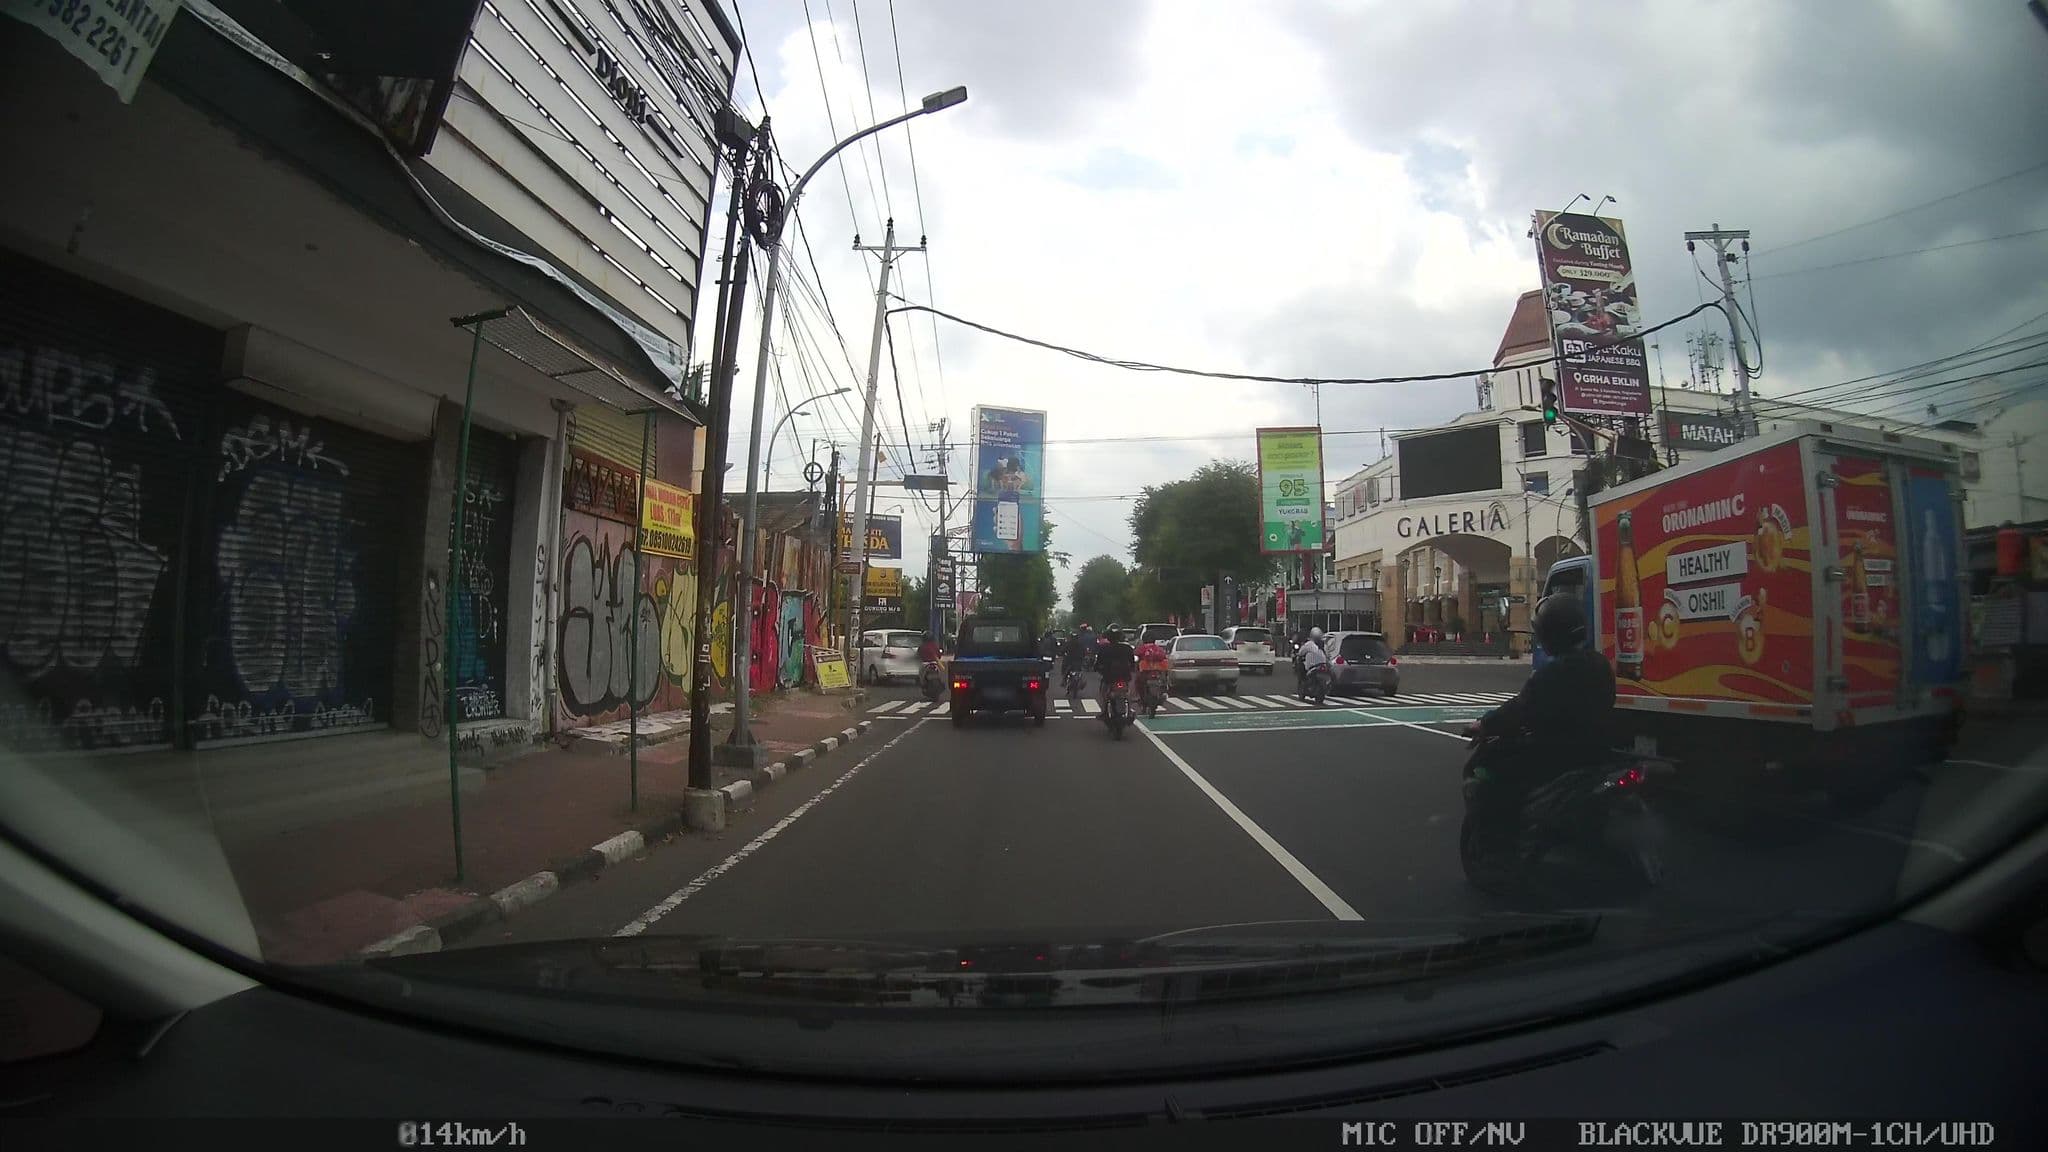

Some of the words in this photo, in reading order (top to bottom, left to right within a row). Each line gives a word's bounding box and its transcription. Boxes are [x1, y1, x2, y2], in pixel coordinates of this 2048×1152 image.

[1560, 227, 1619, 246] Ramadan
[1582, 243, 1620, 260] Buffet
[1588, 354, 1624, 365] JAPANESE
[1626, 358, 1640, 367] BBQ
[1583, 375, 1610, 384] GRHA
[1612, 376, 1639, 387] EKLIN
[1682, 424, 1734, 444] MATAH
[1397, 509, 1505, 538] GALERIA
[1679, 550, 1730, 577] HEALTHY
